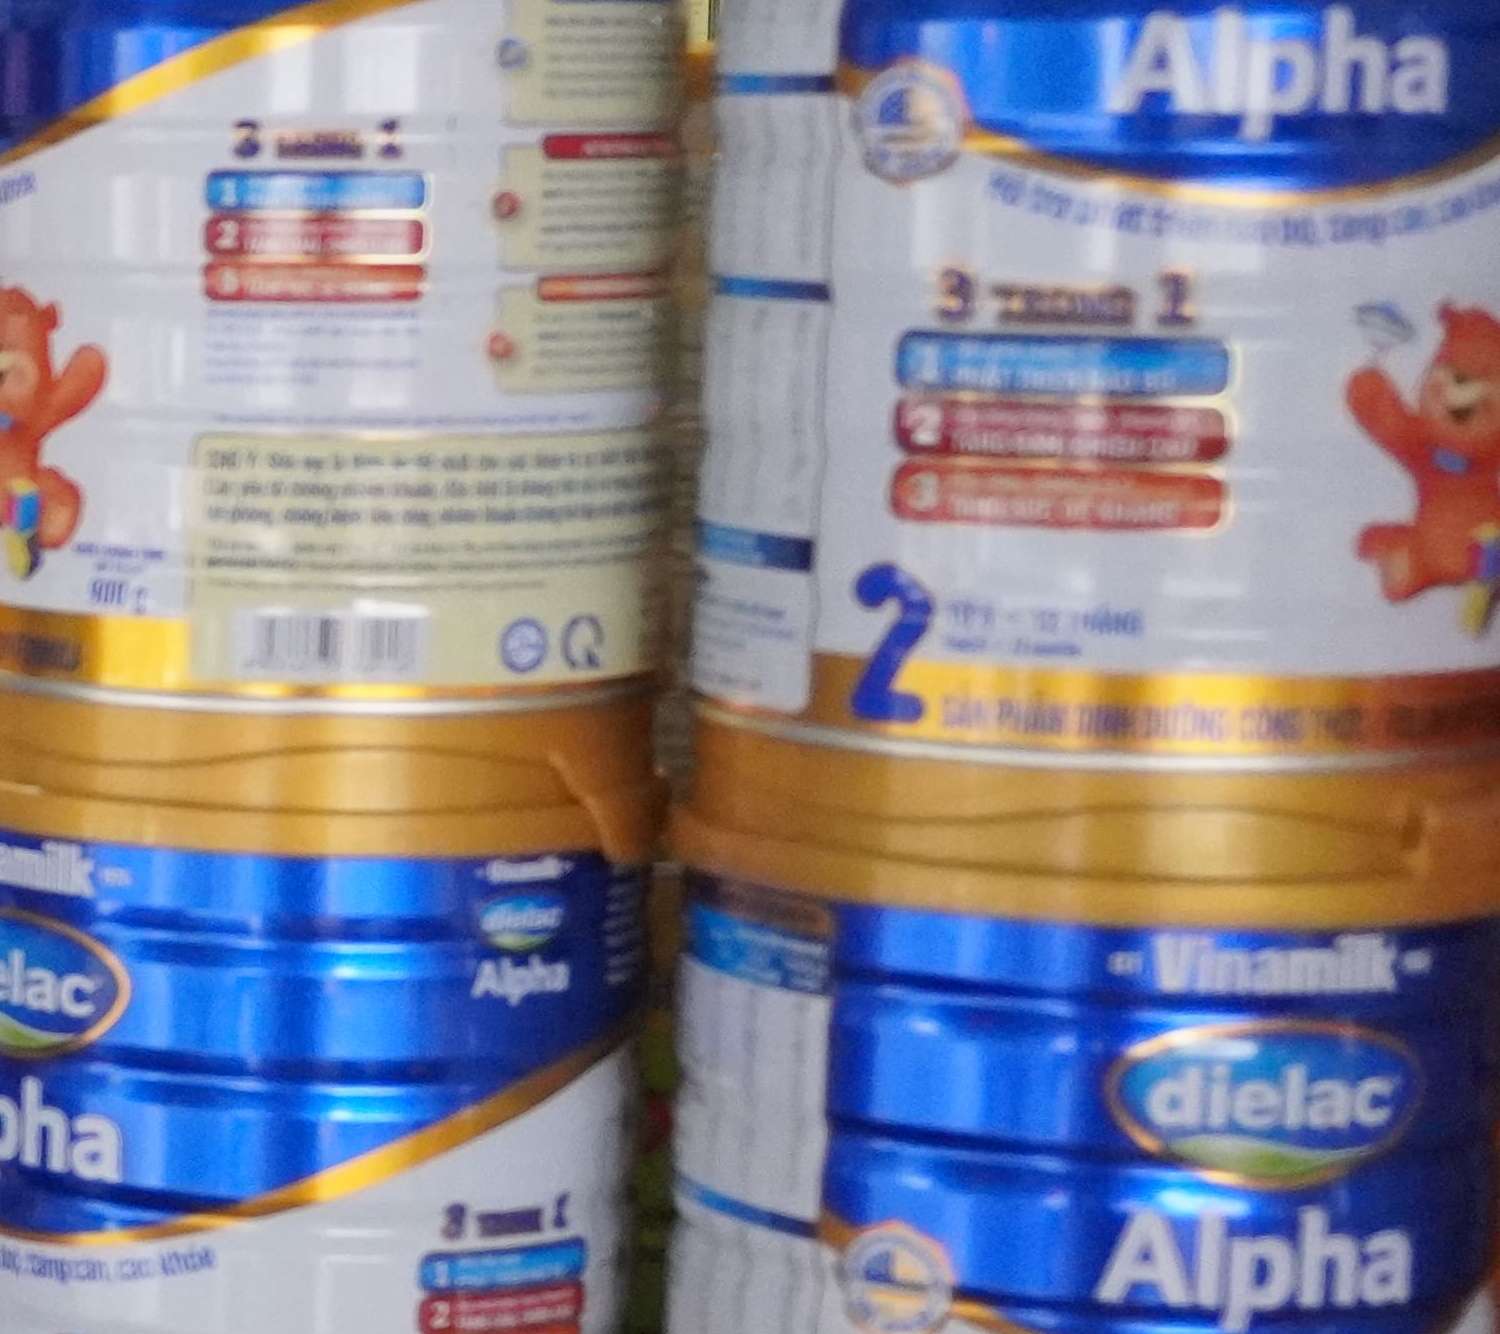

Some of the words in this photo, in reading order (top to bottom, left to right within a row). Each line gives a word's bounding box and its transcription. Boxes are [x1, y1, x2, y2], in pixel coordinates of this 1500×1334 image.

[1104, 4, 1450, 143] Alpha
[851, 562, 934, 724] 2
[470, 957, 571, 1008] Alpha
[1151, 932, 1398, 995] Vinamilk
[1147, 1067, 1398, 1131] dielac
